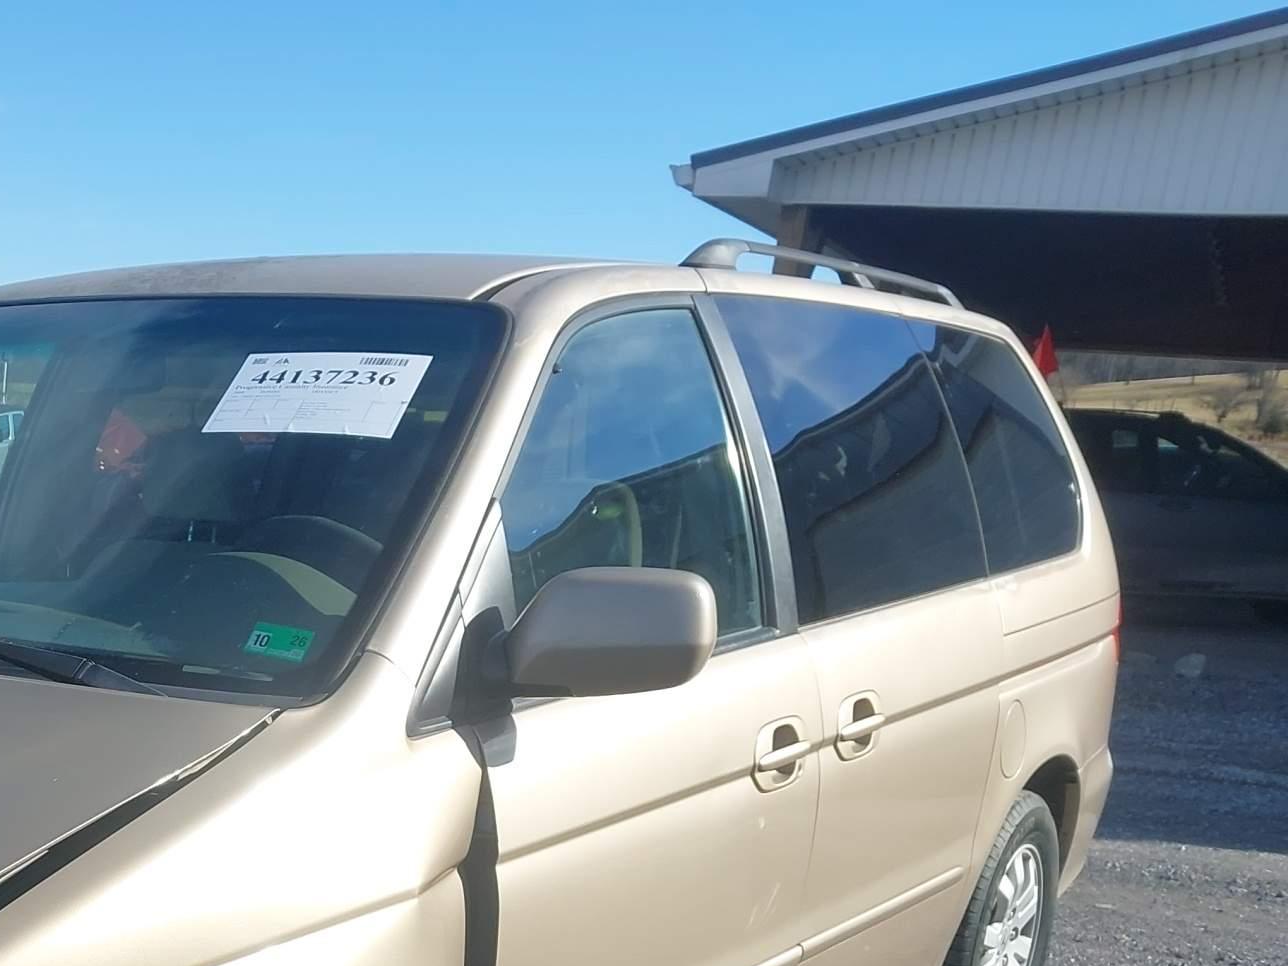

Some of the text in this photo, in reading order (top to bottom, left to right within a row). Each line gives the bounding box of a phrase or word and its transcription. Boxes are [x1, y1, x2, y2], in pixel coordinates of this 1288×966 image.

[251, 370, 397, 387] 44137236
[253, 633, 309, 648] 10 26
